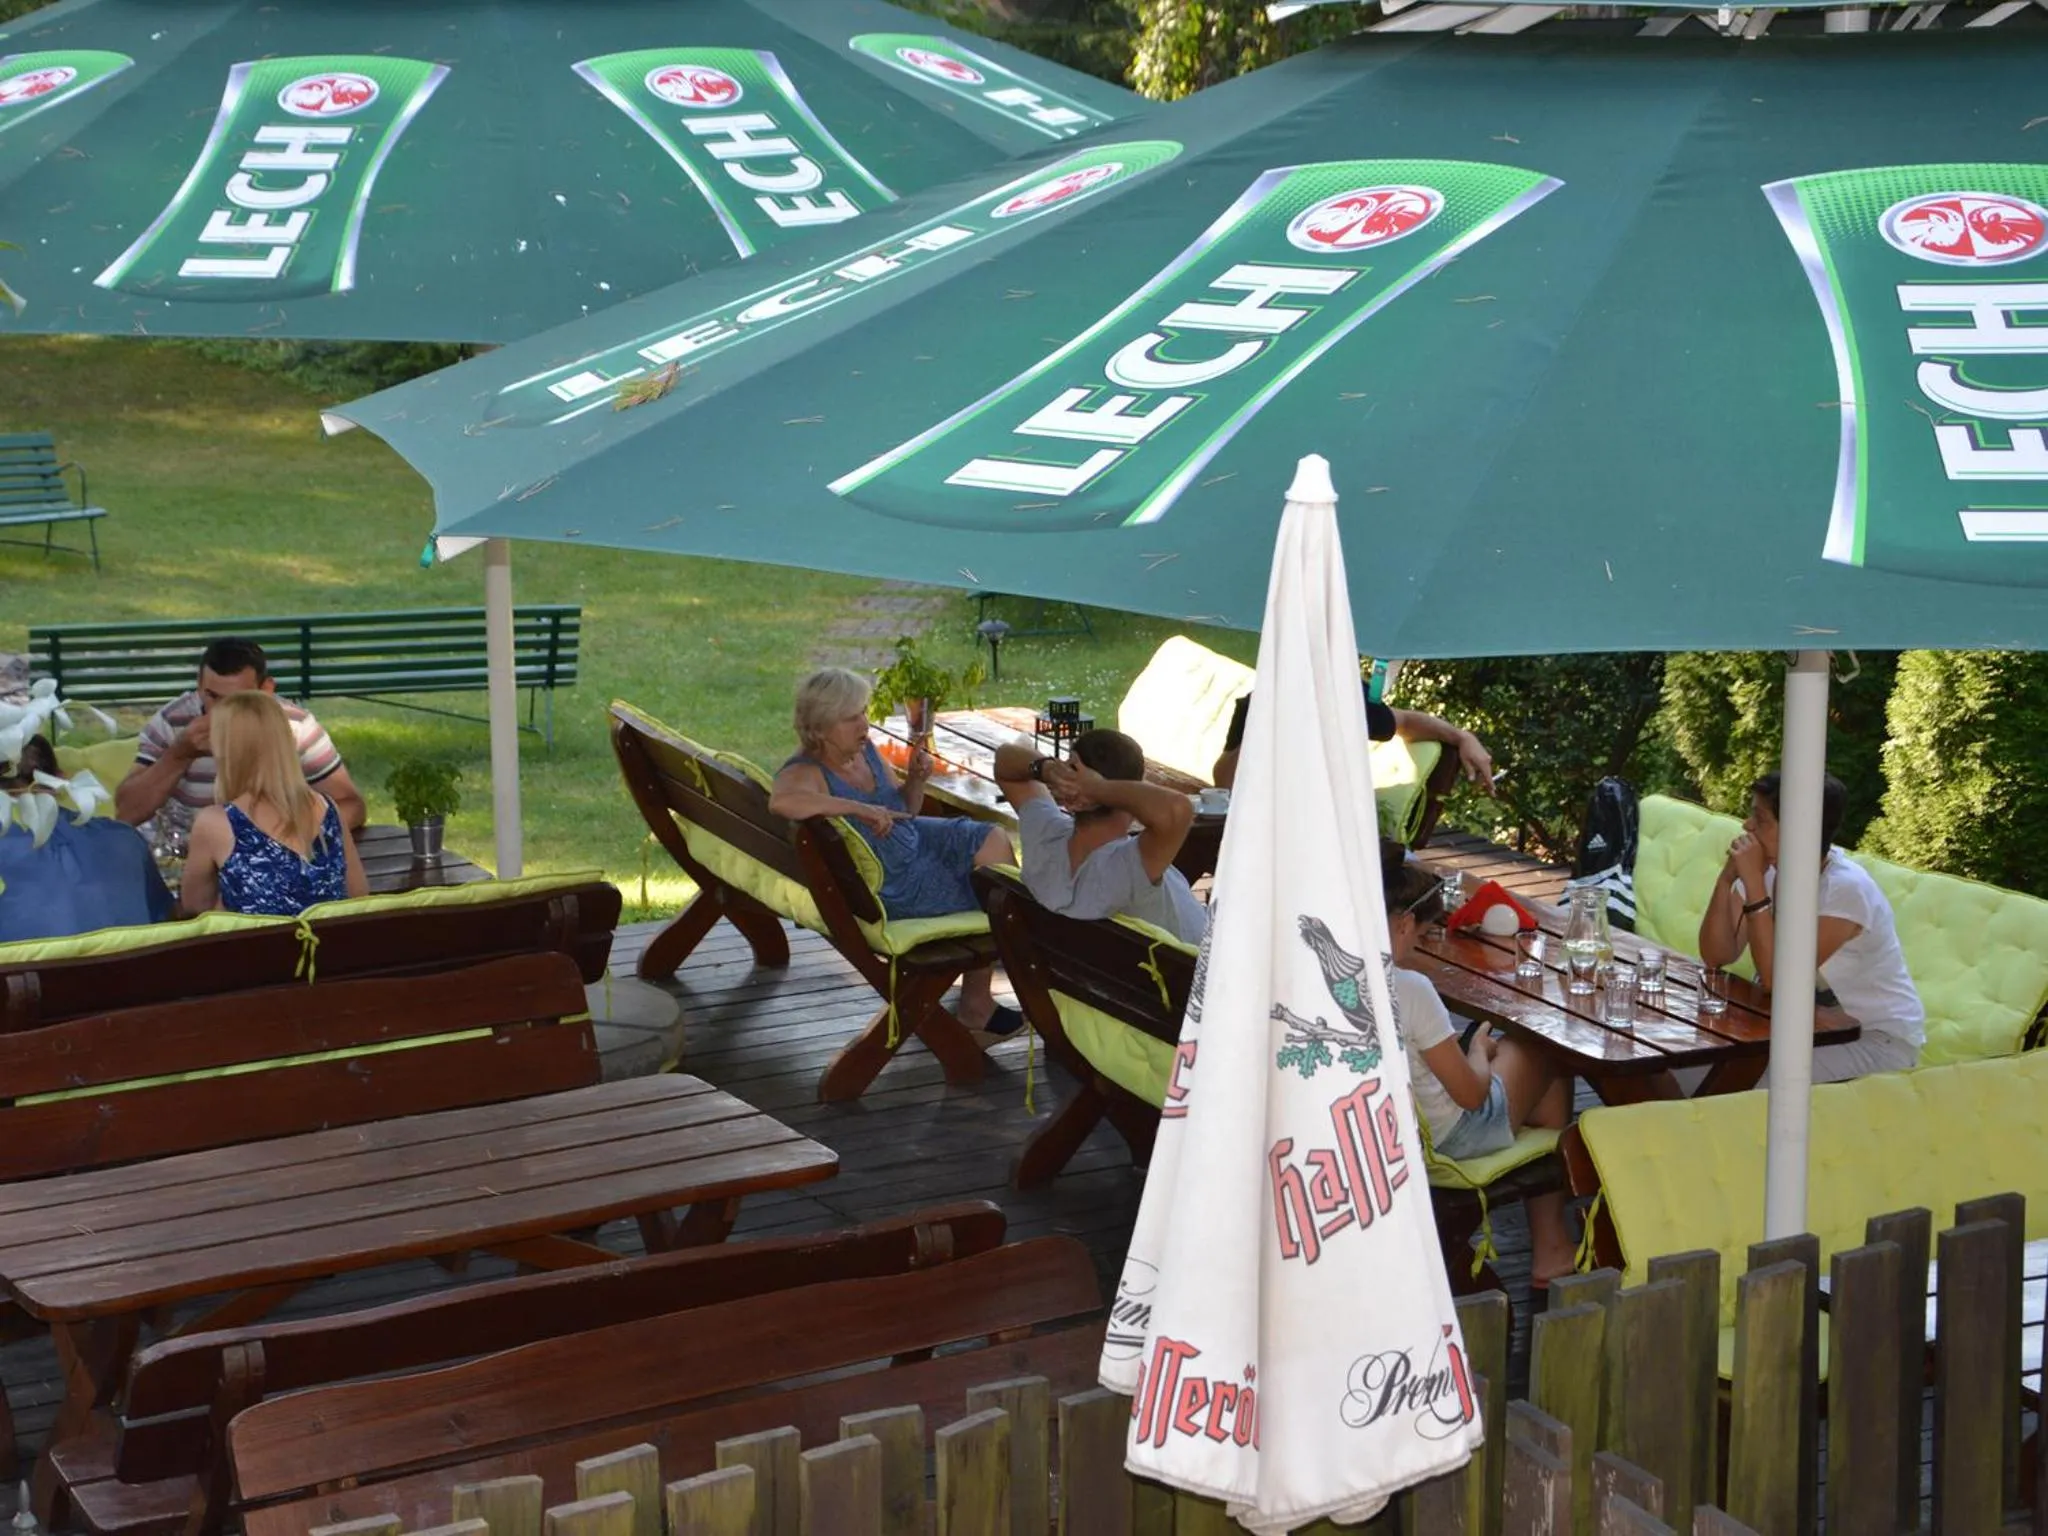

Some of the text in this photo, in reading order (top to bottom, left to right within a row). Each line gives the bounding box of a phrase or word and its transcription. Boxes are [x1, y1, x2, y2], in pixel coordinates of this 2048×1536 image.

[178, 125, 353, 278] LECH
[681, 112, 861, 228] ECH
[547, 225, 975, 402] LECH
[943, 263, 1361, 496] LECH
